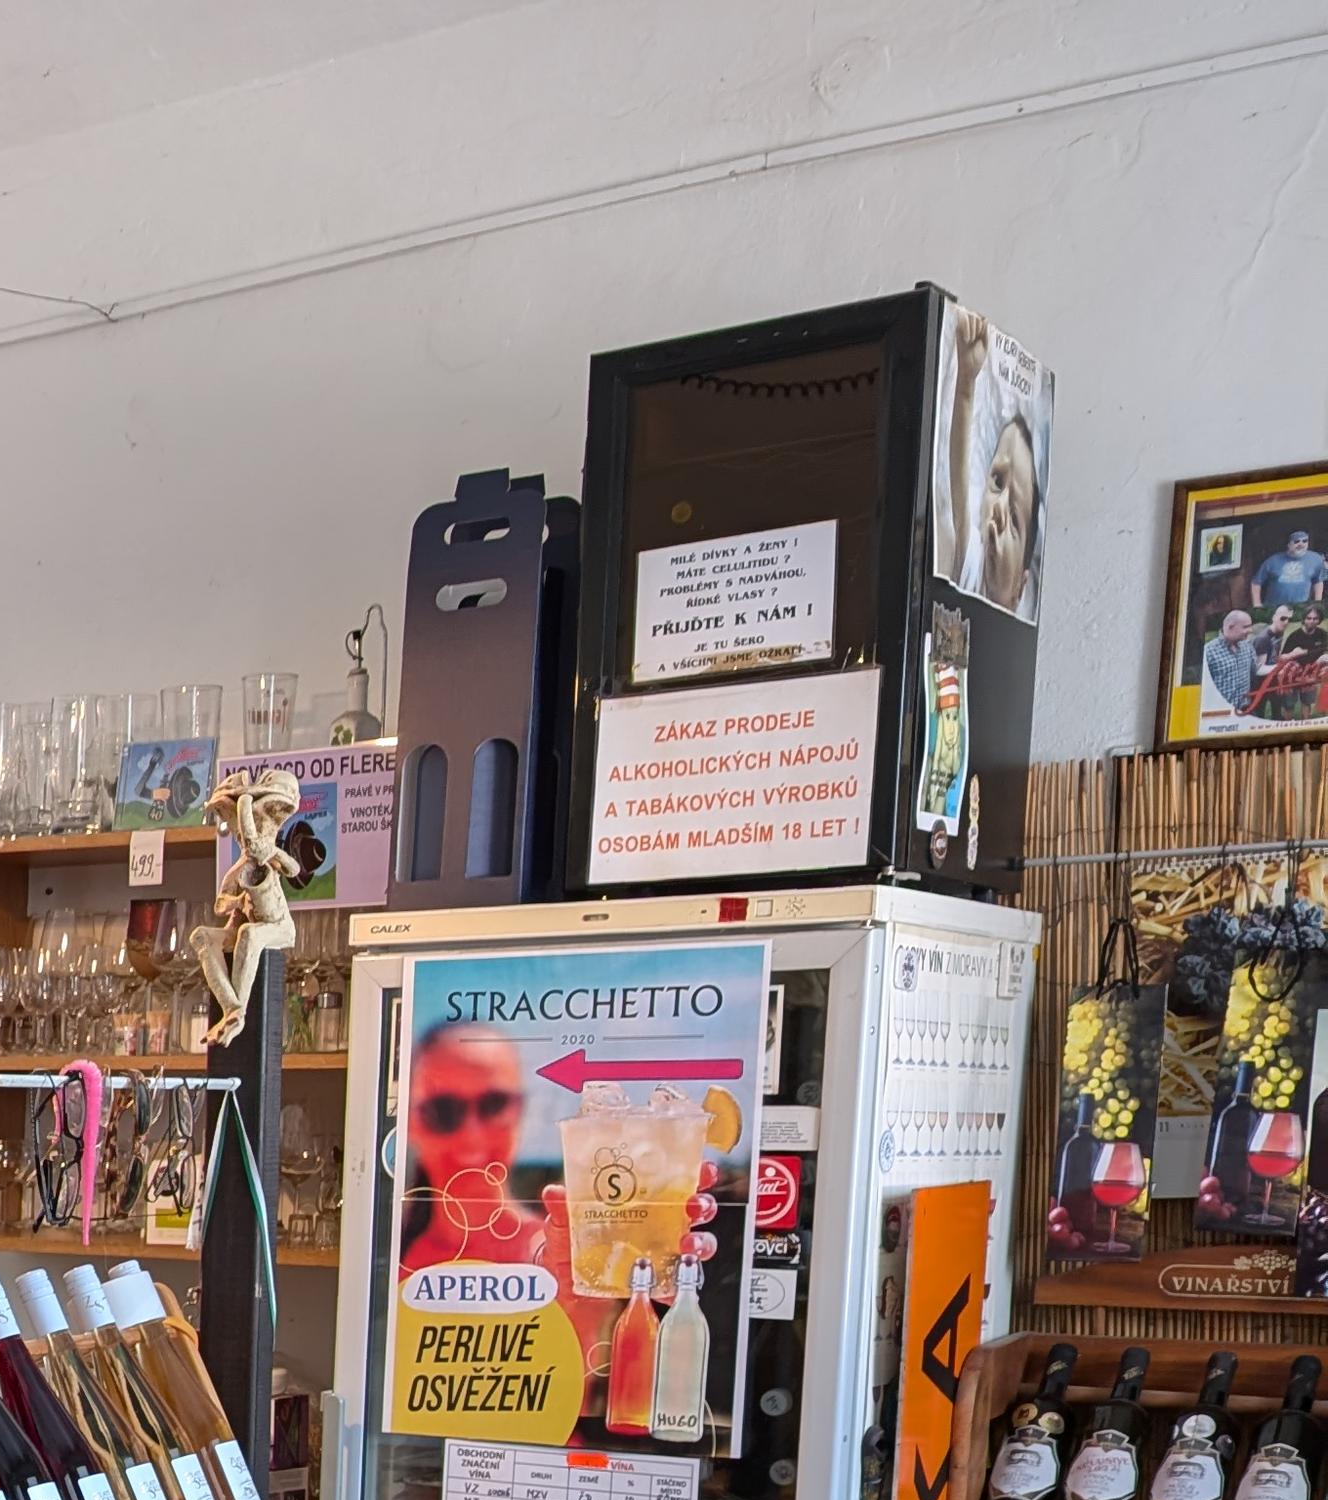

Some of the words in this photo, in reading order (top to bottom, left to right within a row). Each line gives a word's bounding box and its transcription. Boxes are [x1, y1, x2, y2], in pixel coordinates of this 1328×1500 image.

[744, 547, 752, 555] A
[651, 613, 725, 638] PŘIJĎTE
[734, 612, 747, 625] K
[756, 603, 797, 622] NÁM
[654, 719, 718, 743] ZÁKAZ
[724, 709, 816, 737] PRODEJE
[310, 757, 335, 779] OD
[609, 750, 771, 782] ALKOHOLICKÝCH
[779, 738, 859, 767] NÁPOJŮ
[604, 802, 618, 818] A
[626, 784, 755, 817] TABÁKOVÝCH
[763, 774, 858, 805] VÝROBKŮ
[598, 829, 680, 854] OSOBÁM
[687, 821, 774, 849] MLADŠÍM
[781, 823, 802, 840] 18
[810, 818, 846, 838] LET
[854, 817, 860, 835] !
[370, 923, 412, 936] CALEX
[446, 984, 724, 1023] STRACCHETTO
[561, 1033, 596, 1046] 2020
[414, 1273, 546, 1302] APEROL
[1172, 1273, 1290, 1296] VINAŘSTVÍ
[415, 1315, 541, 1364] PERLIVÉ
[407, 1366, 556, 1413] OSVĚŽENÍ
[657, 1412, 698, 1429] HUGO
[469, 1469, 491, 1480] VÍNA
[610, 1461, 635, 1472] VÍNA
